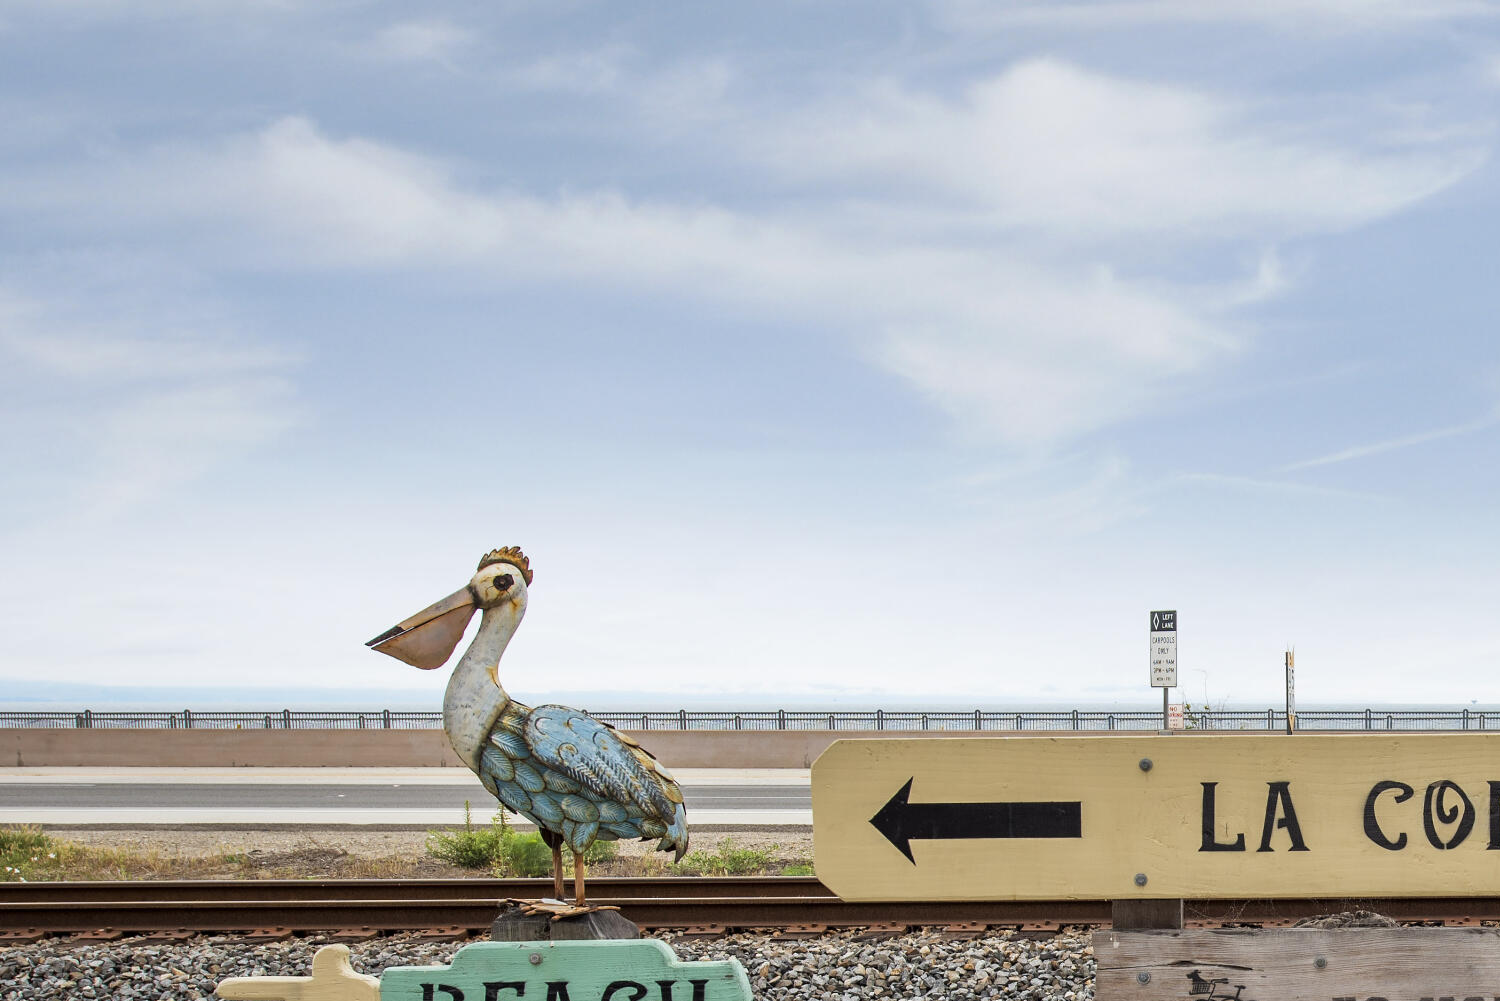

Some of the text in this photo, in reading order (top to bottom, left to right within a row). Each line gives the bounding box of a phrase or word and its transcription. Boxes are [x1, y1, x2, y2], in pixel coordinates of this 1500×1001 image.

[1152, 636, 1175, 644] CARPOOLS
[1157, 647, 1169, 655] ONLY
[1199, 781, 1310, 852] LA
